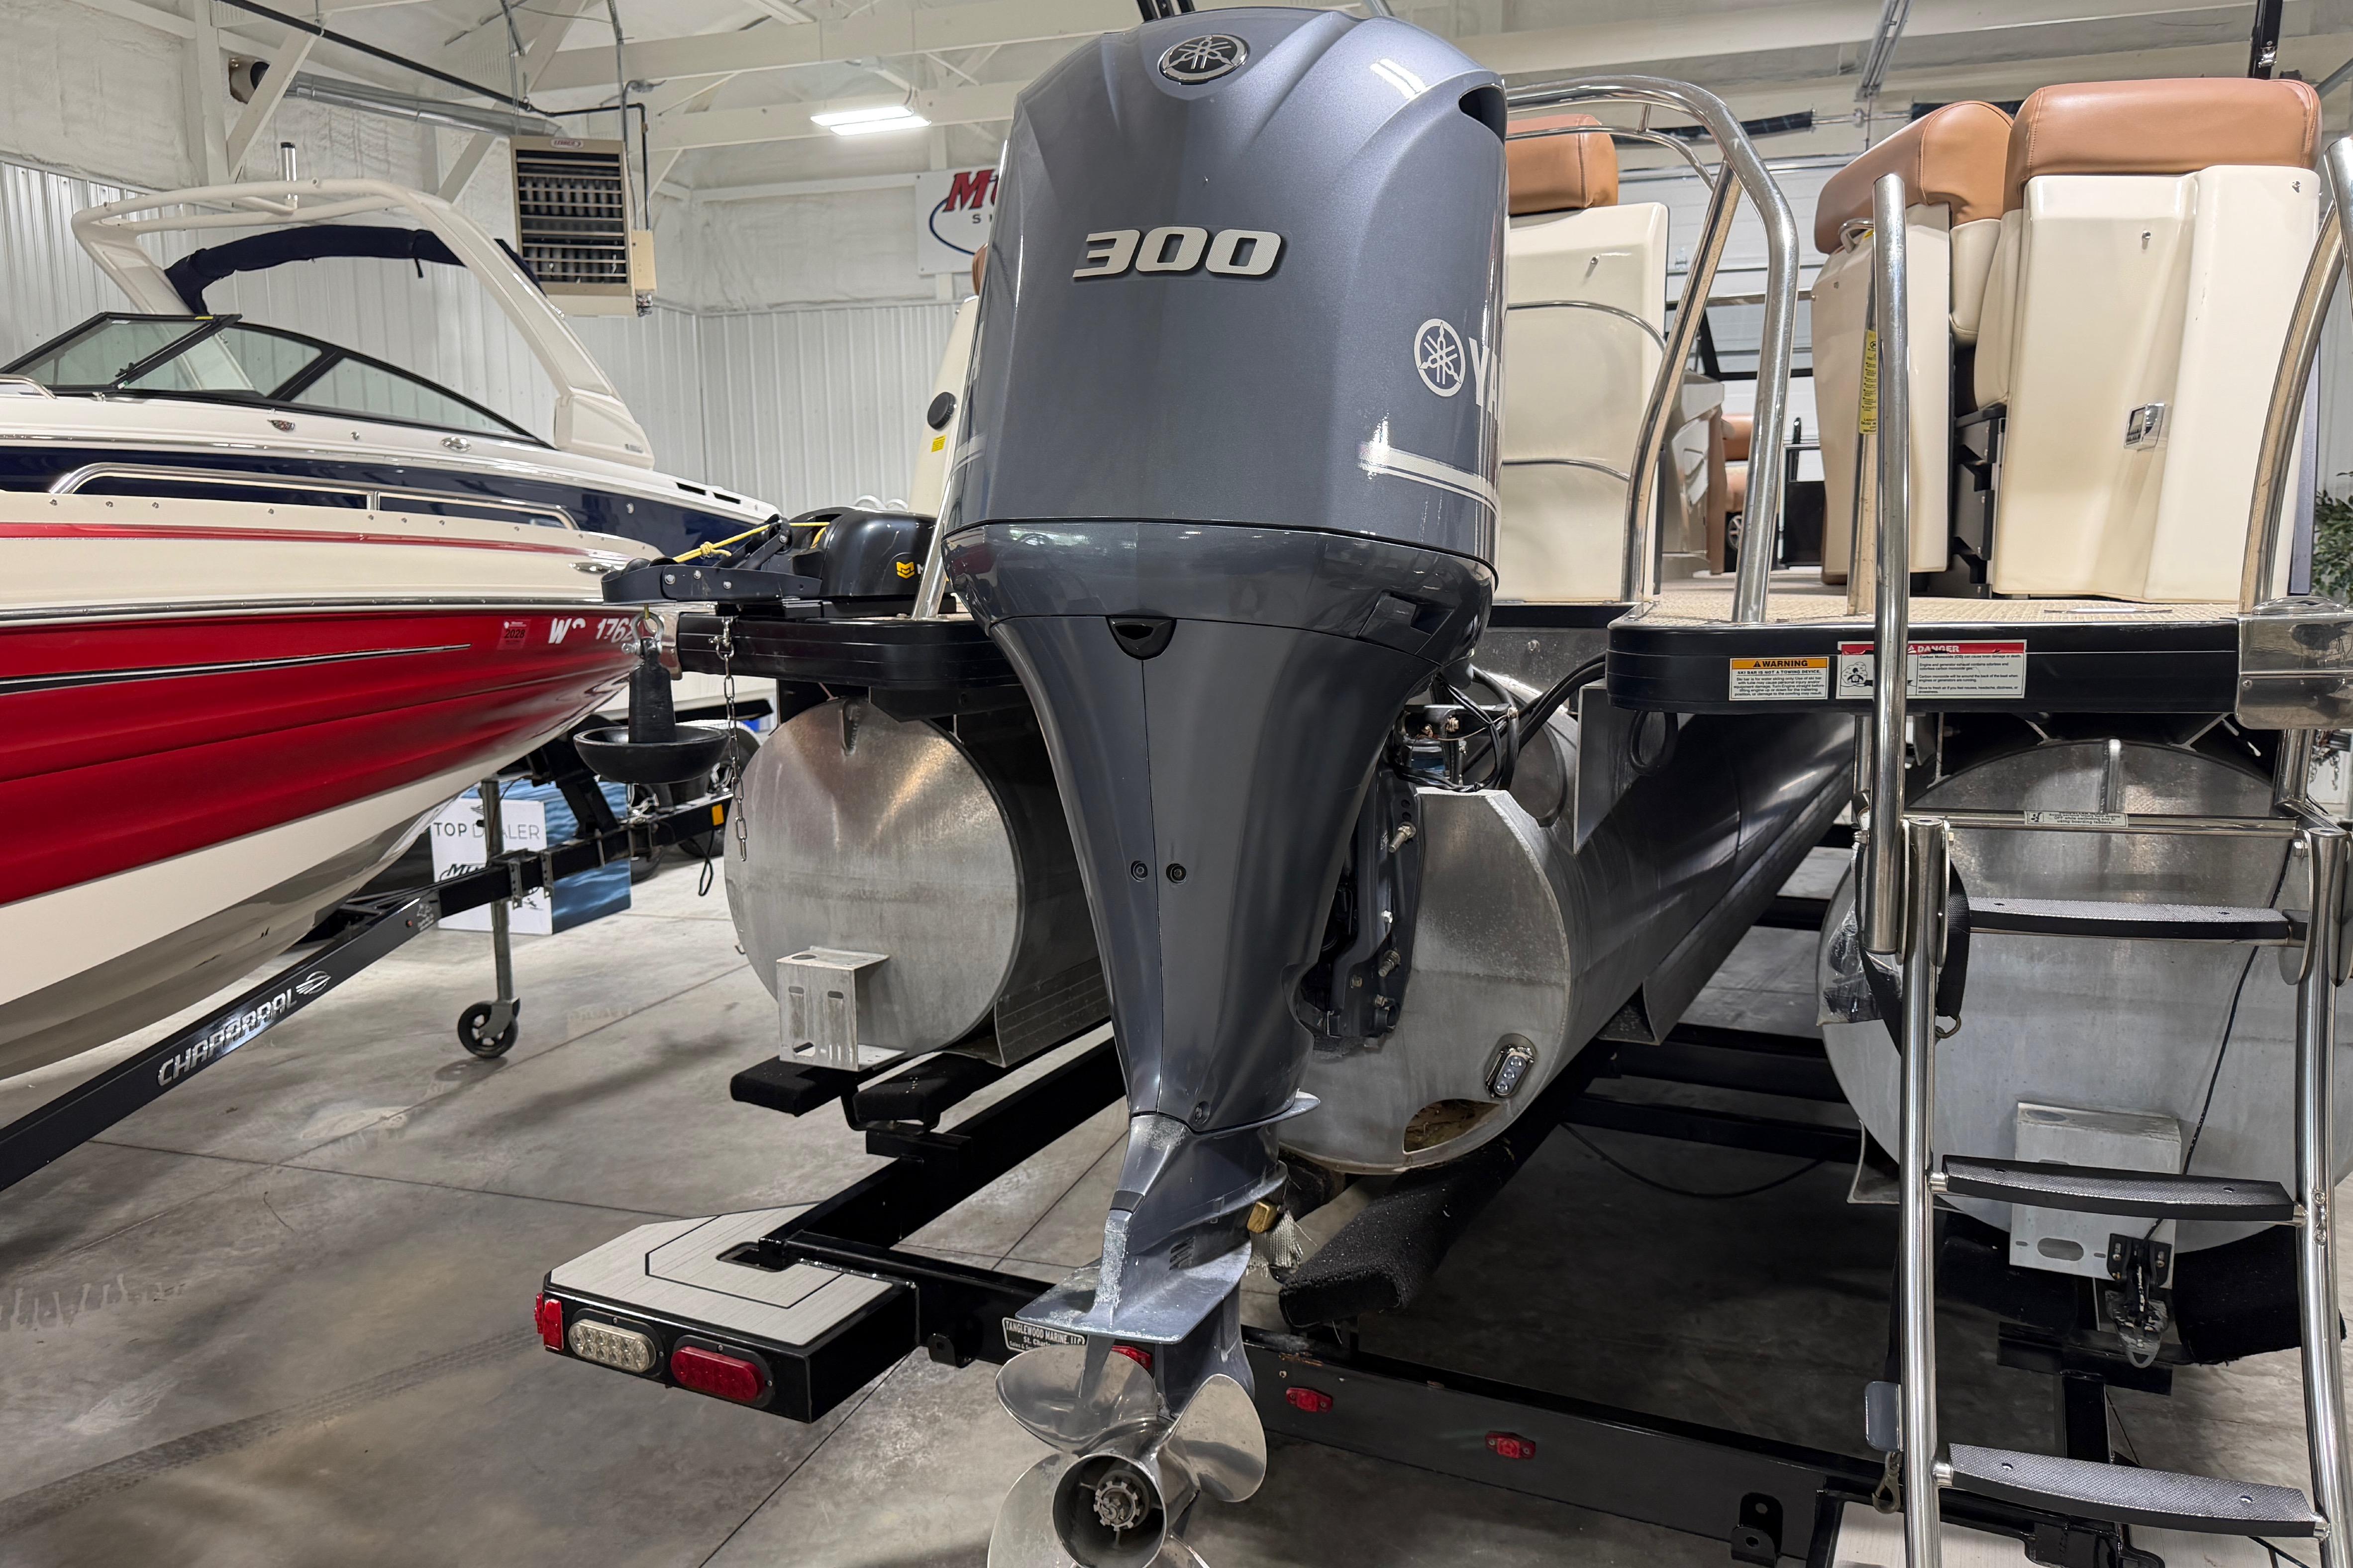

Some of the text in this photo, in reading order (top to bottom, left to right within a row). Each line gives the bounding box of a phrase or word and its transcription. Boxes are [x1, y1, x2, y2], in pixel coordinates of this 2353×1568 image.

[1073, 226, 1282, 278] 300
[504, 629, 525, 639] 2028
[434, 822, 540, 840] TOP DLER
[157, 988, 298, 1086] CHAPARRAL
[1005, 1320, 1044, 1339] TANGLEWOOD
